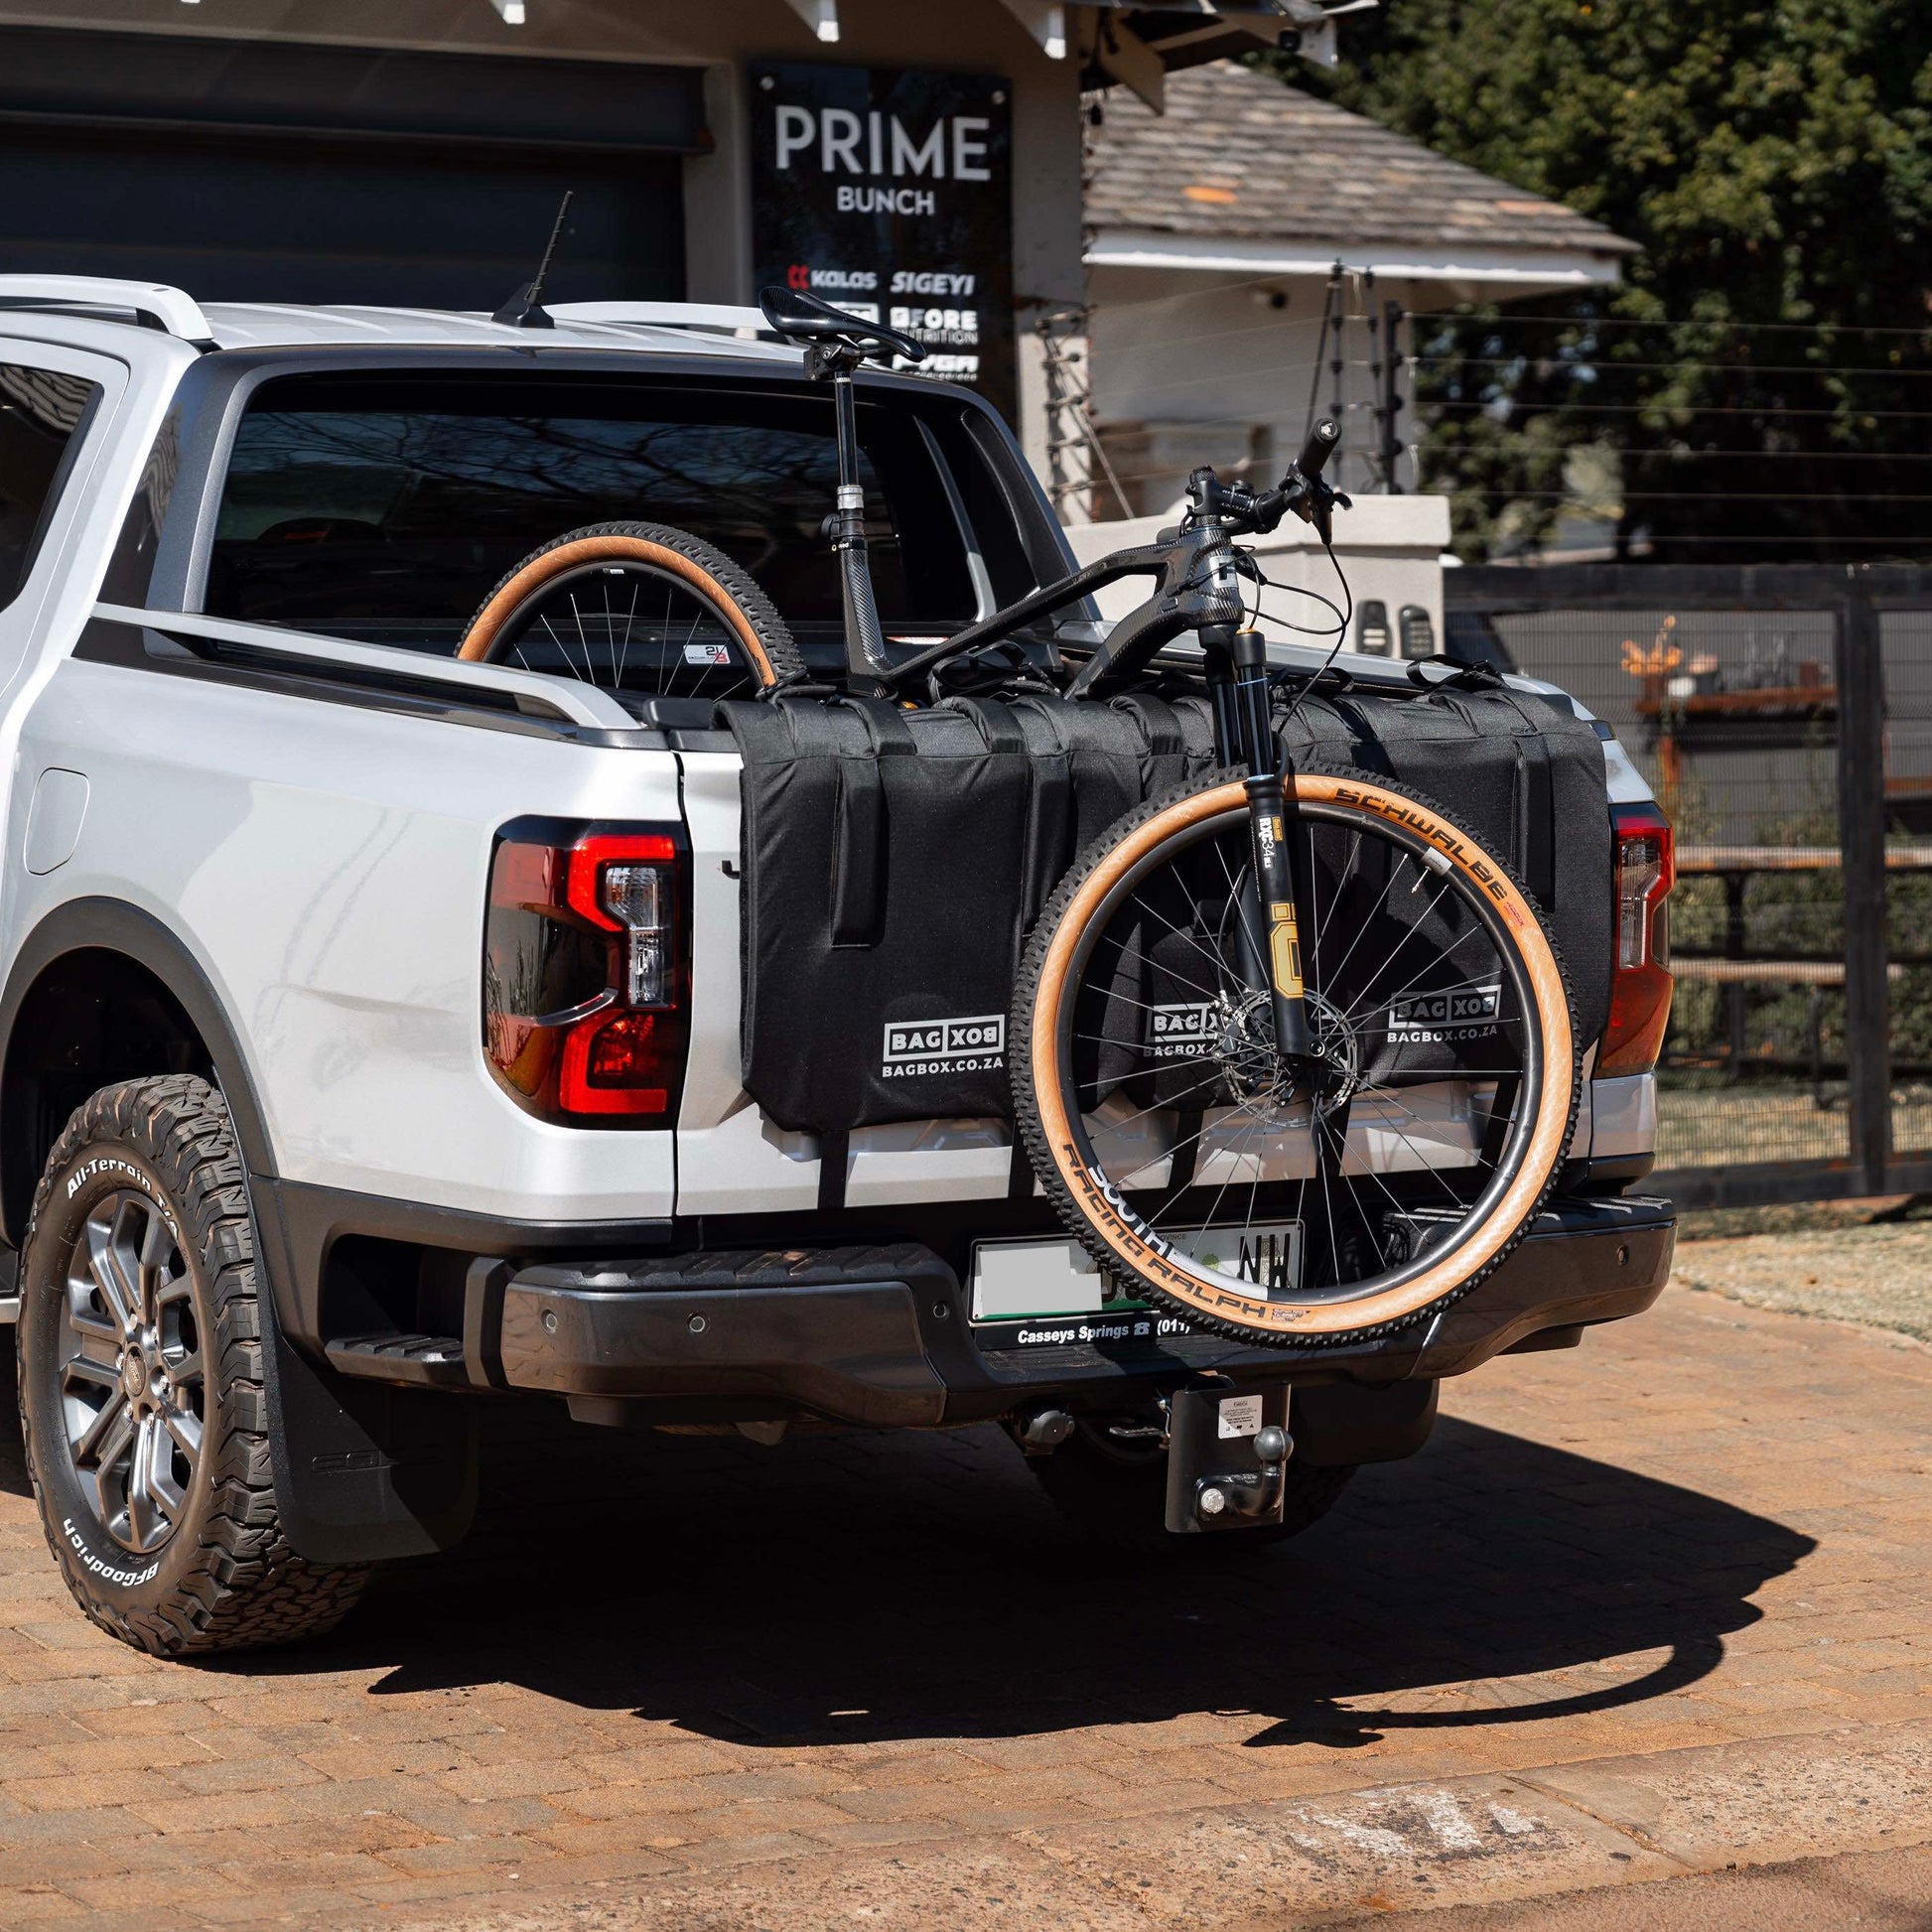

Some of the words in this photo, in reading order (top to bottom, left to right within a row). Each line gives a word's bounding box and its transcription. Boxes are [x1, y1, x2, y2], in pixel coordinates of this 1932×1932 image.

[775, 105, 991, 181] PRIME
[837, 186, 935, 215] BUNCH
[890, 271, 976, 296] SIGEYI
[1334, 787, 1508, 901] SCHWALBE
[1396, 1001, 1446, 1019] BAG
[1154, 1014, 1200, 1032] BAG
[1387, 1025, 1497, 1043] BAGBOX.CO.ZA
[892, 1031, 942, 1051] BAG
[882, 1056, 1004, 1078] BAGBOX.CO.ZA
[67, 1159, 151, 1199] All-Terrain
[1063, 1144, 1146, 1258] RACING
[1147, 1257, 1267, 1319] RALPH
[1018, 1329, 1075, 1344] Casseys
[1078, 1324, 1130, 1341] Springs
[63, 1518, 160, 1587] BFGoodrich
